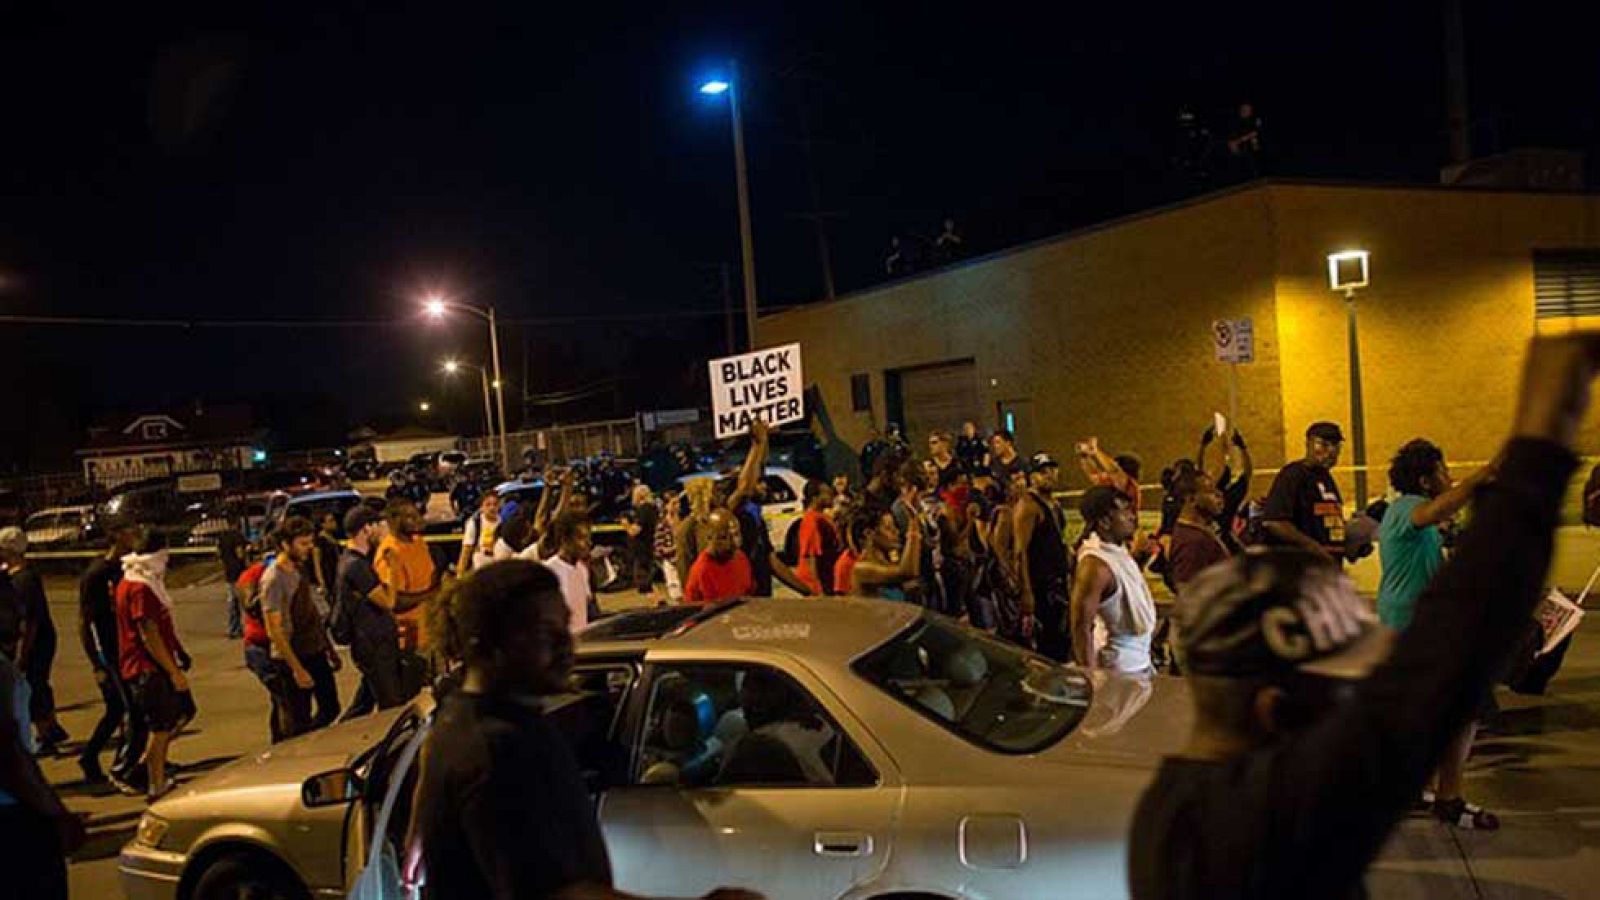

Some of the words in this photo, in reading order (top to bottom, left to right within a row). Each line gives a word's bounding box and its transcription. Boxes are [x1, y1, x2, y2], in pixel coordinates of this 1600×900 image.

[722, 351, 791, 383] BLACK
[730, 377, 788, 407] LIVES
[719, 397, 800, 433] MATTER
